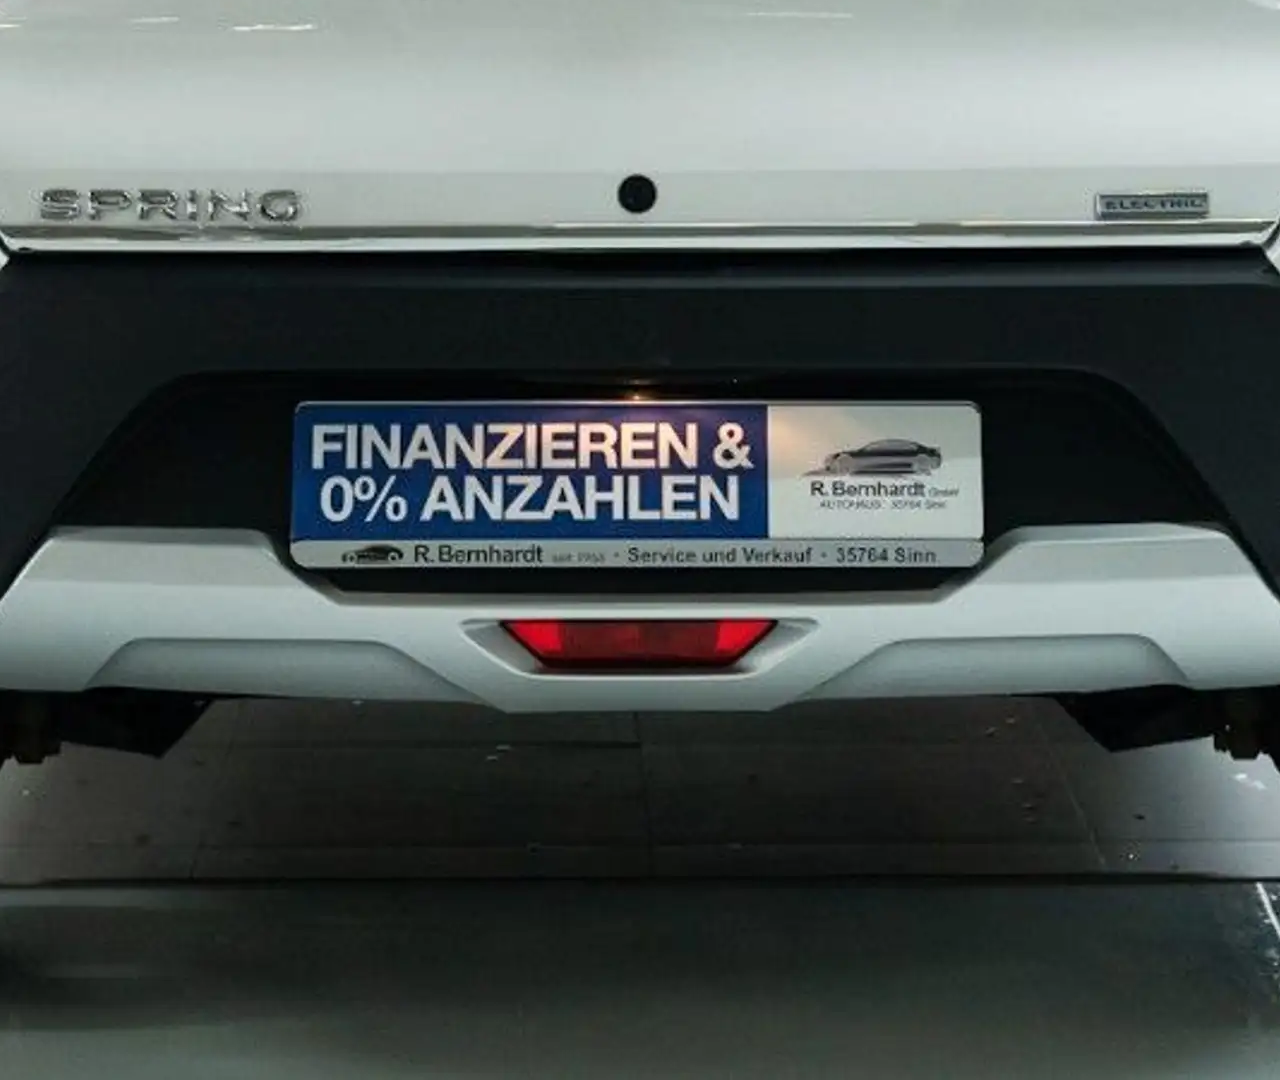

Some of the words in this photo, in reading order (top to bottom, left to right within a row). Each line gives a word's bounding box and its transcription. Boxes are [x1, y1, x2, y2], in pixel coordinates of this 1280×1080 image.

[39, 188, 300, 221] SPRING
[311, 423, 699, 470] FINANZIEREN
[713, 422, 755, 470] &
[320, 475, 409, 521] 0%
[420, 475, 740, 521] ANZAHLEN
[810, 480, 829, 497] R.
[832, 479, 926, 497] Bernhardt
[413, 544, 435, 564] R.
[438, 543, 544, 564] Bernhardt
[627, 546, 697, 564] Service
[702, 546, 736, 564] und
[741, 546, 812, 564] Verkauf
[835, 547, 888, 564] 35764
[893, 546, 937, 564] Sinn
